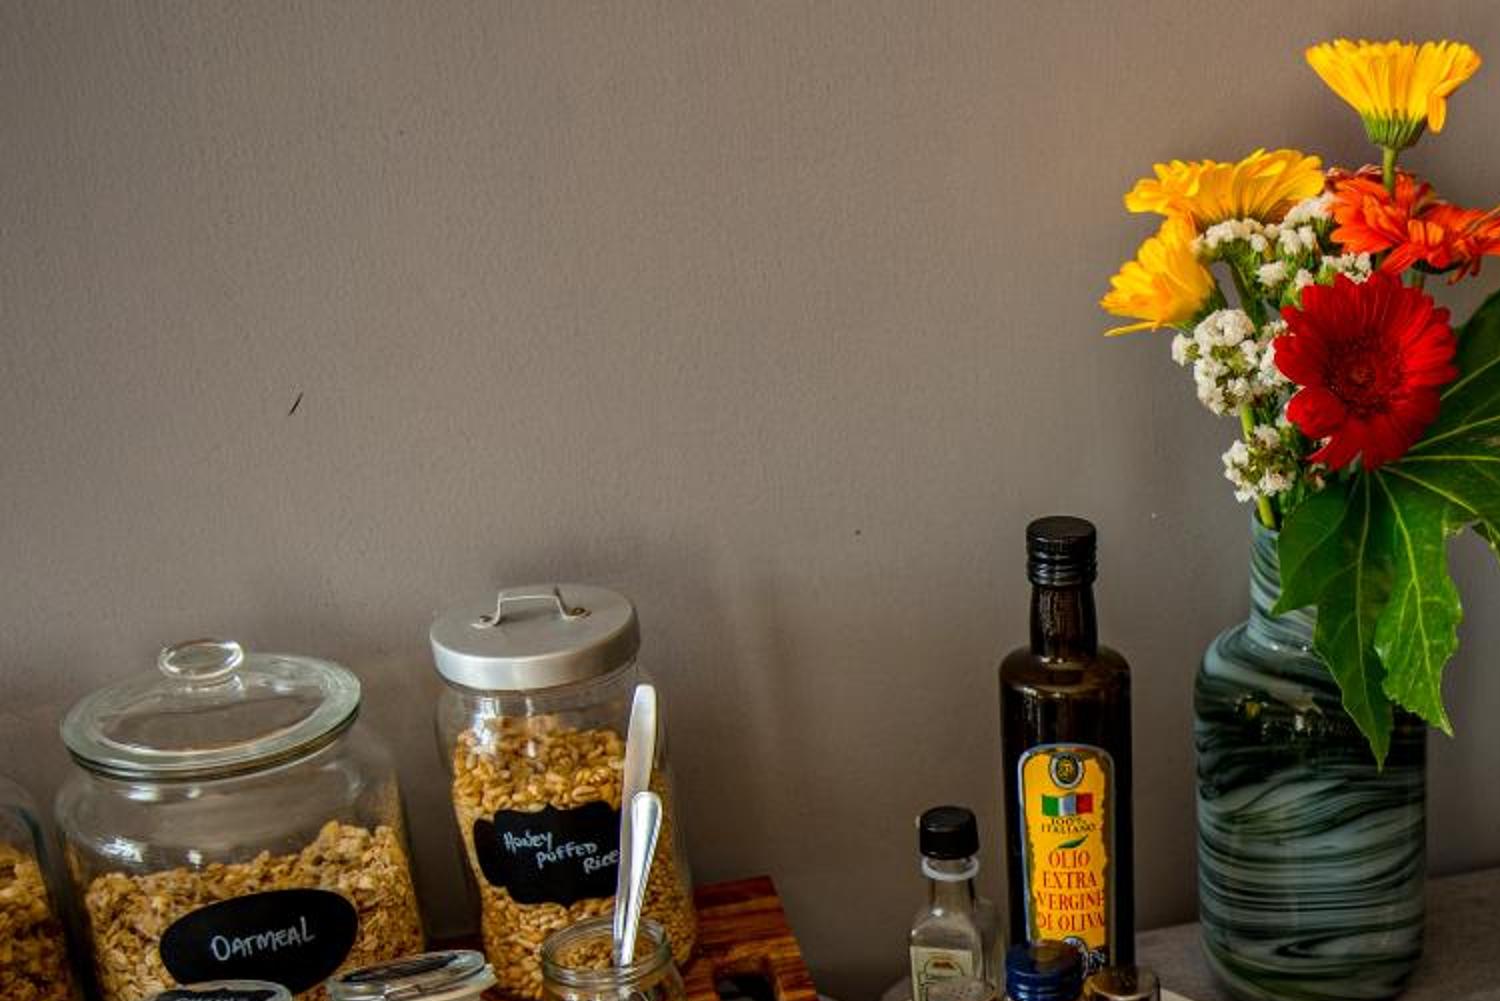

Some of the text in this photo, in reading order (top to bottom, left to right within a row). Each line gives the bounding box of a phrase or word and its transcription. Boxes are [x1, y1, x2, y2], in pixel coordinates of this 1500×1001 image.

[1047, 849, 1091, 869] OLIO
[1042, 871, 1098, 889] EXTRA
[1036, 890, 1105, 911] VERGINE
[1037, 911, 1105, 931] DI OLIVA
